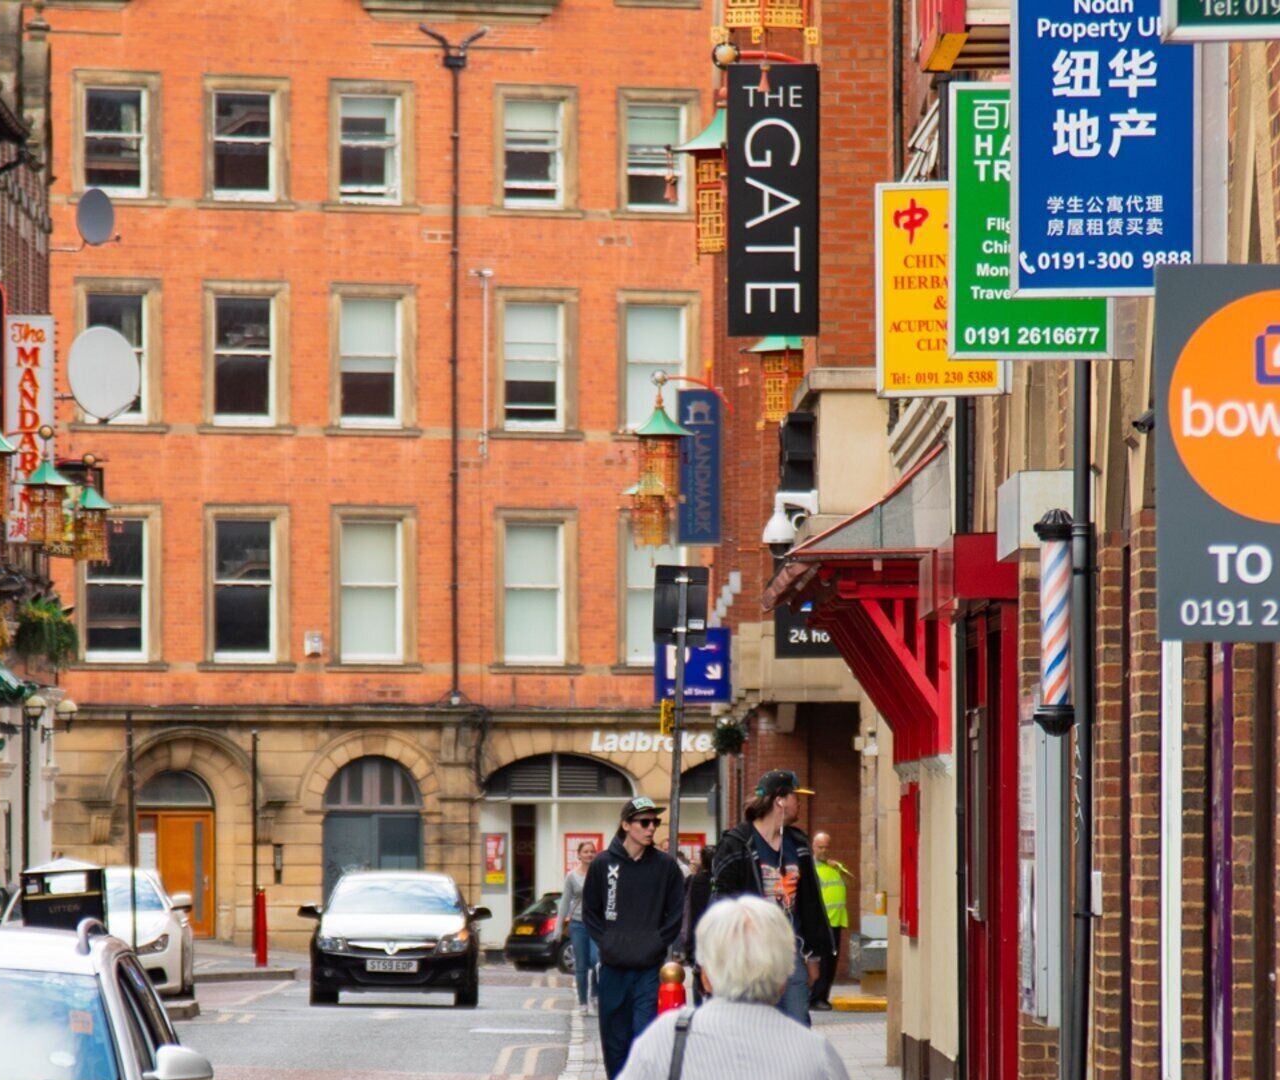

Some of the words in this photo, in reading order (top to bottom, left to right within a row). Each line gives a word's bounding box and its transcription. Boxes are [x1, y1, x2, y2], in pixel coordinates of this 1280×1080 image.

[1036, 17, 1133, 43] Property
[1051, 48, 1158, 98] 纽华
[742, 85, 803, 108] THE
[1051, 108, 1158, 158] 地产
[1046, 194, 1164, 214] 学生公寓代理
[744, 117, 801, 315] GATE
[1046, 217, 1164, 237] 房屋租赁买卖
[1037, 251, 1134, 270] 0191-300
[933, 295, 947, 310] &
[9, 322, 46, 344] The
[964, 326, 1010, 345] 0191
[1017, 326, 1100, 345] 2616677
[890, 372, 911, 385] Tel:
[915, 371, 939, 384] 0191
[944, 371, 963, 384] 230
[967, 371, 994, 383] 5388
[694, 432, 712, 534] LANDMARK
[1207, 544, 1273, 584] TO
[1180, 599, 1253, 626] 0191
[789, 629, 808, 643] 24
